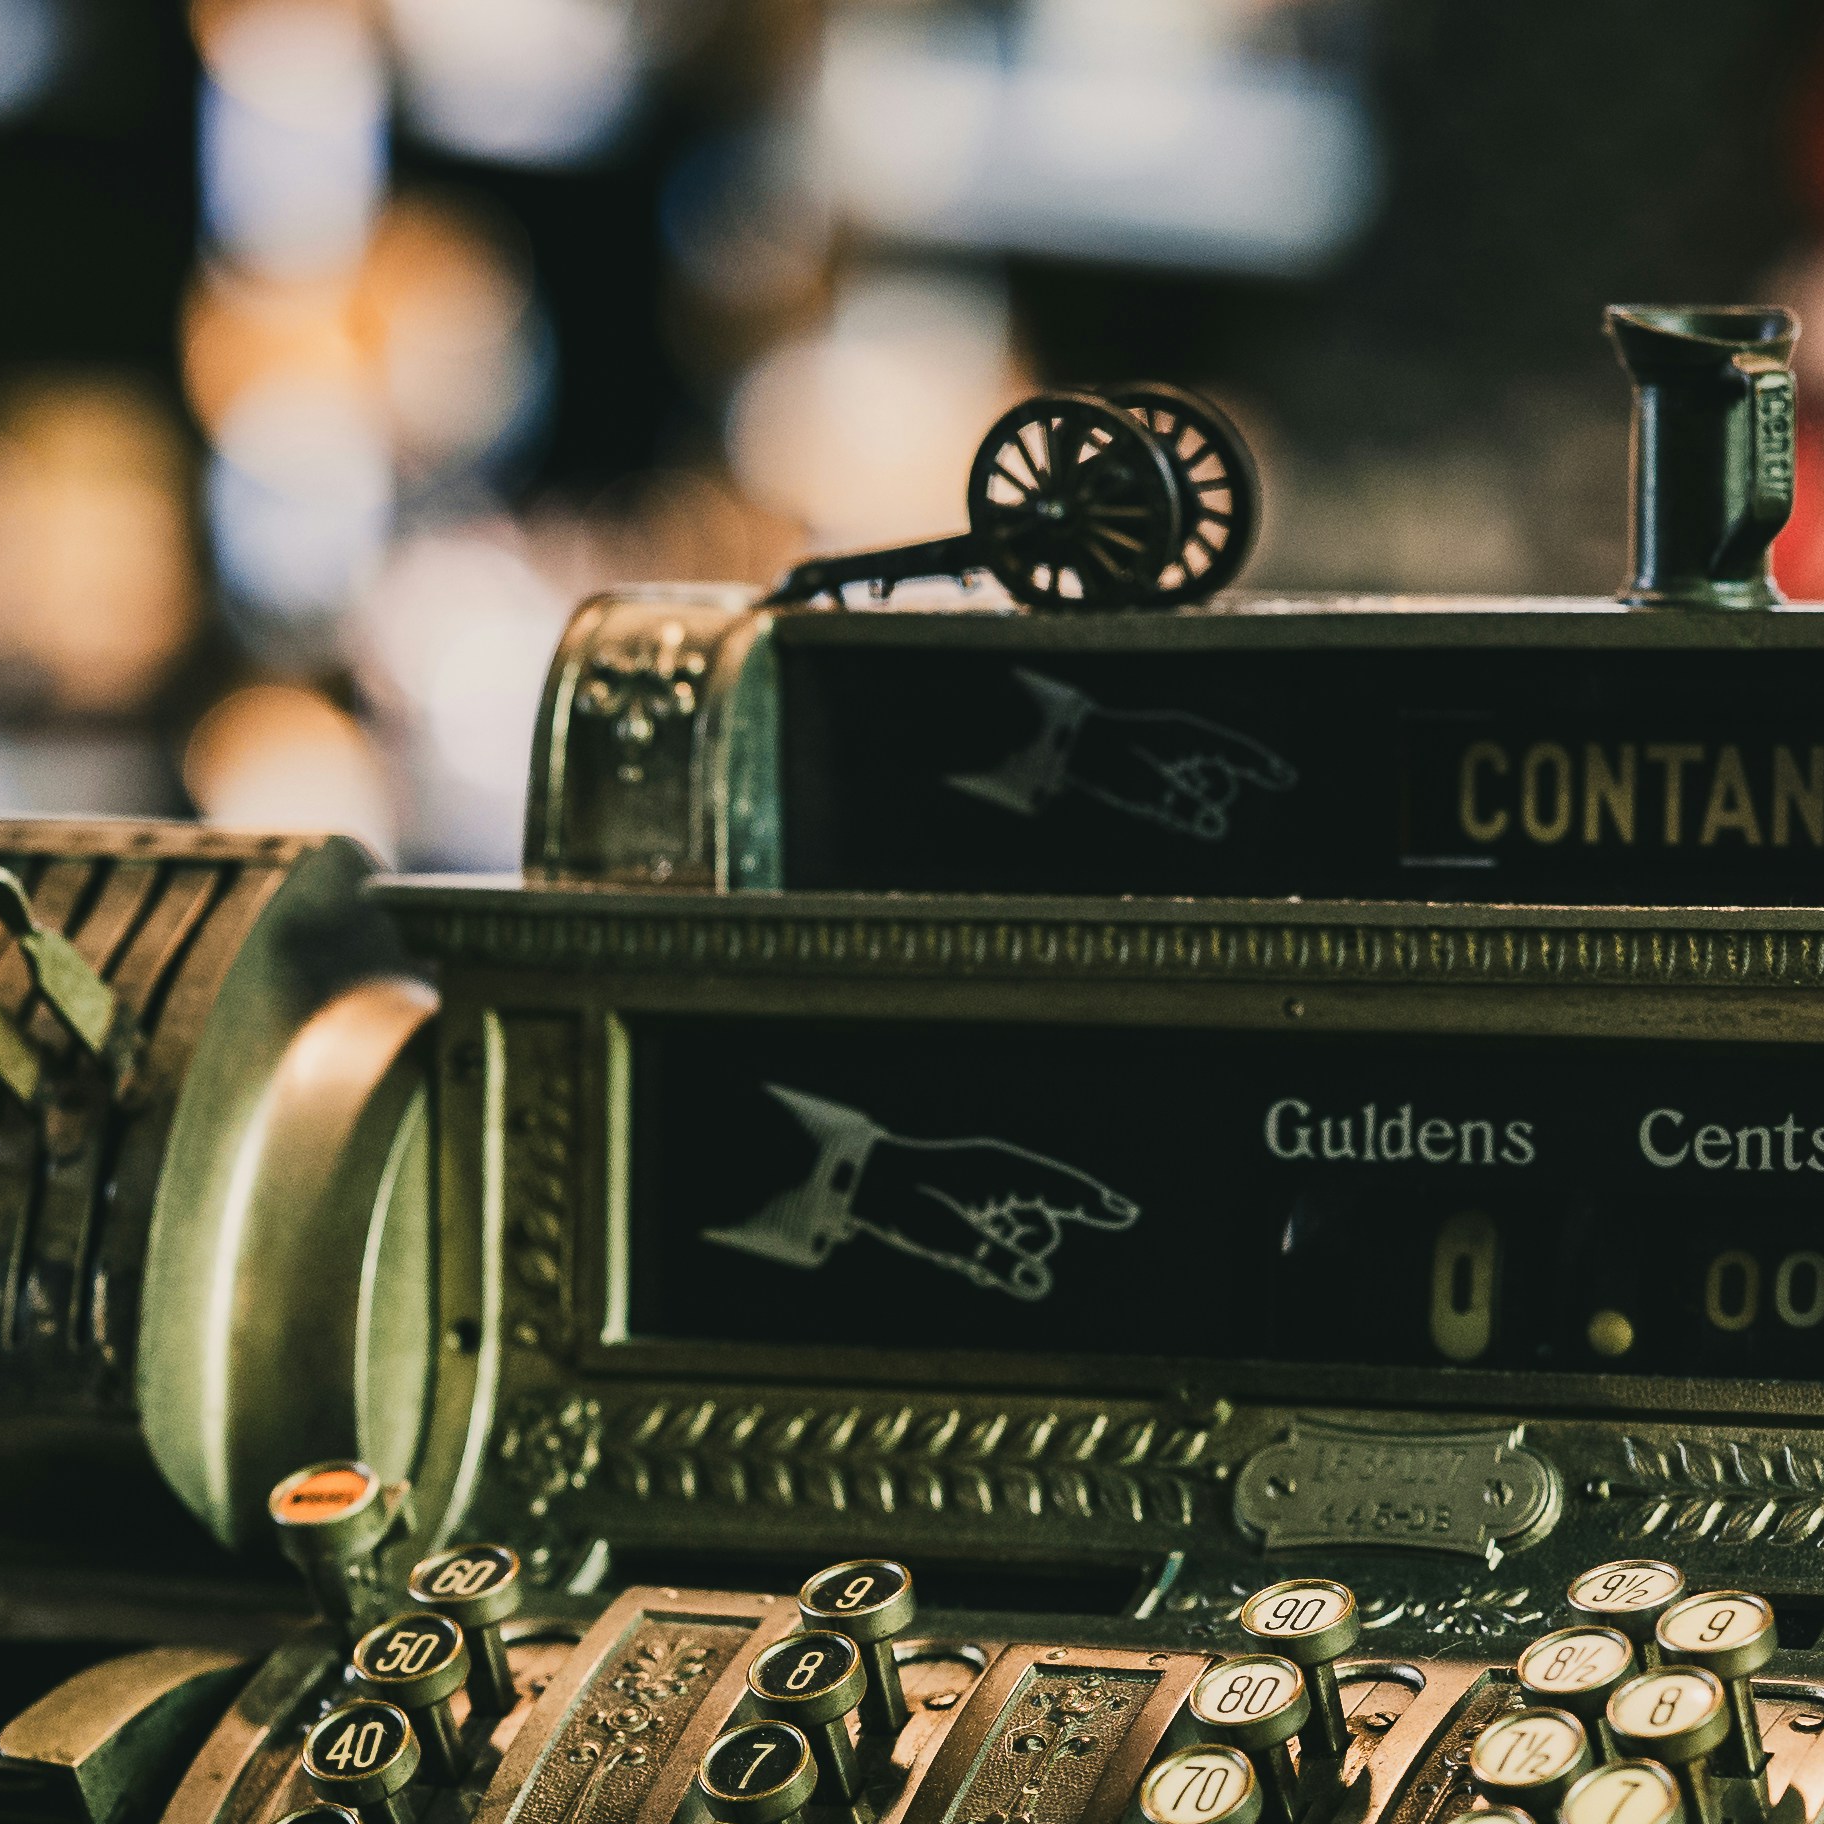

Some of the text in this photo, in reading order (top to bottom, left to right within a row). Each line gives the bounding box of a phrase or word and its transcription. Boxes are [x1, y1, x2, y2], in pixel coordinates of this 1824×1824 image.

[1264, 1096, 1537, 1168] Guldens
[431, 1563, 497, 1594] 60
[835, 1577, 875, 1608] 9
[1265, 1597, 1327, 1631] 90
[1700, 1610, 1736, 1643] 9
[377, 1632, 440, 1674] 50
[786, 1652, 823, 1690] 8
[1217, 1675, 1279, 1716] 80
[1650, 1686, 1684, 1728] 8
[326, 1723, 386, 1770] 40
[738, 1744, 774, 1789] 7
[1183, 1766, 1232, 1814] 70
